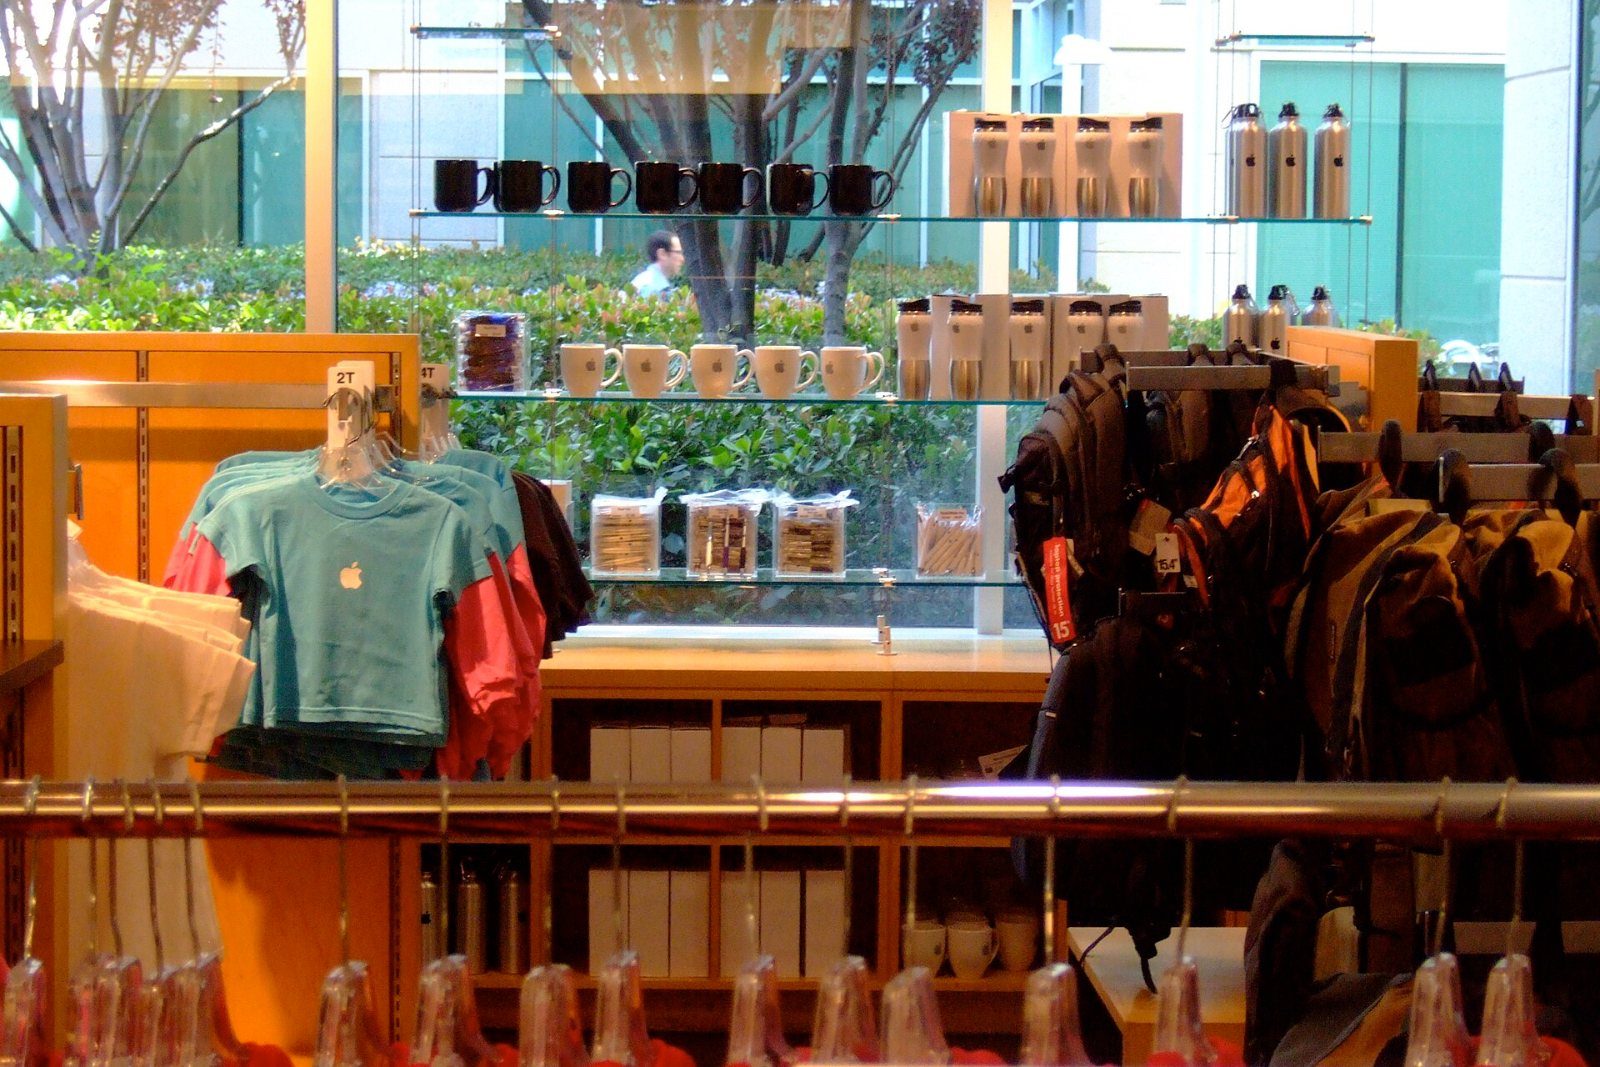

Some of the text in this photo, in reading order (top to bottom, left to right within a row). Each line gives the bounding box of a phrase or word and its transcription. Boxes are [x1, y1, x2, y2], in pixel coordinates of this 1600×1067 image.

[337, 372, 355, 384] 2T
[1053, 544, 1061, 572] laptop
[1055, 574, 1064, 617] protection
